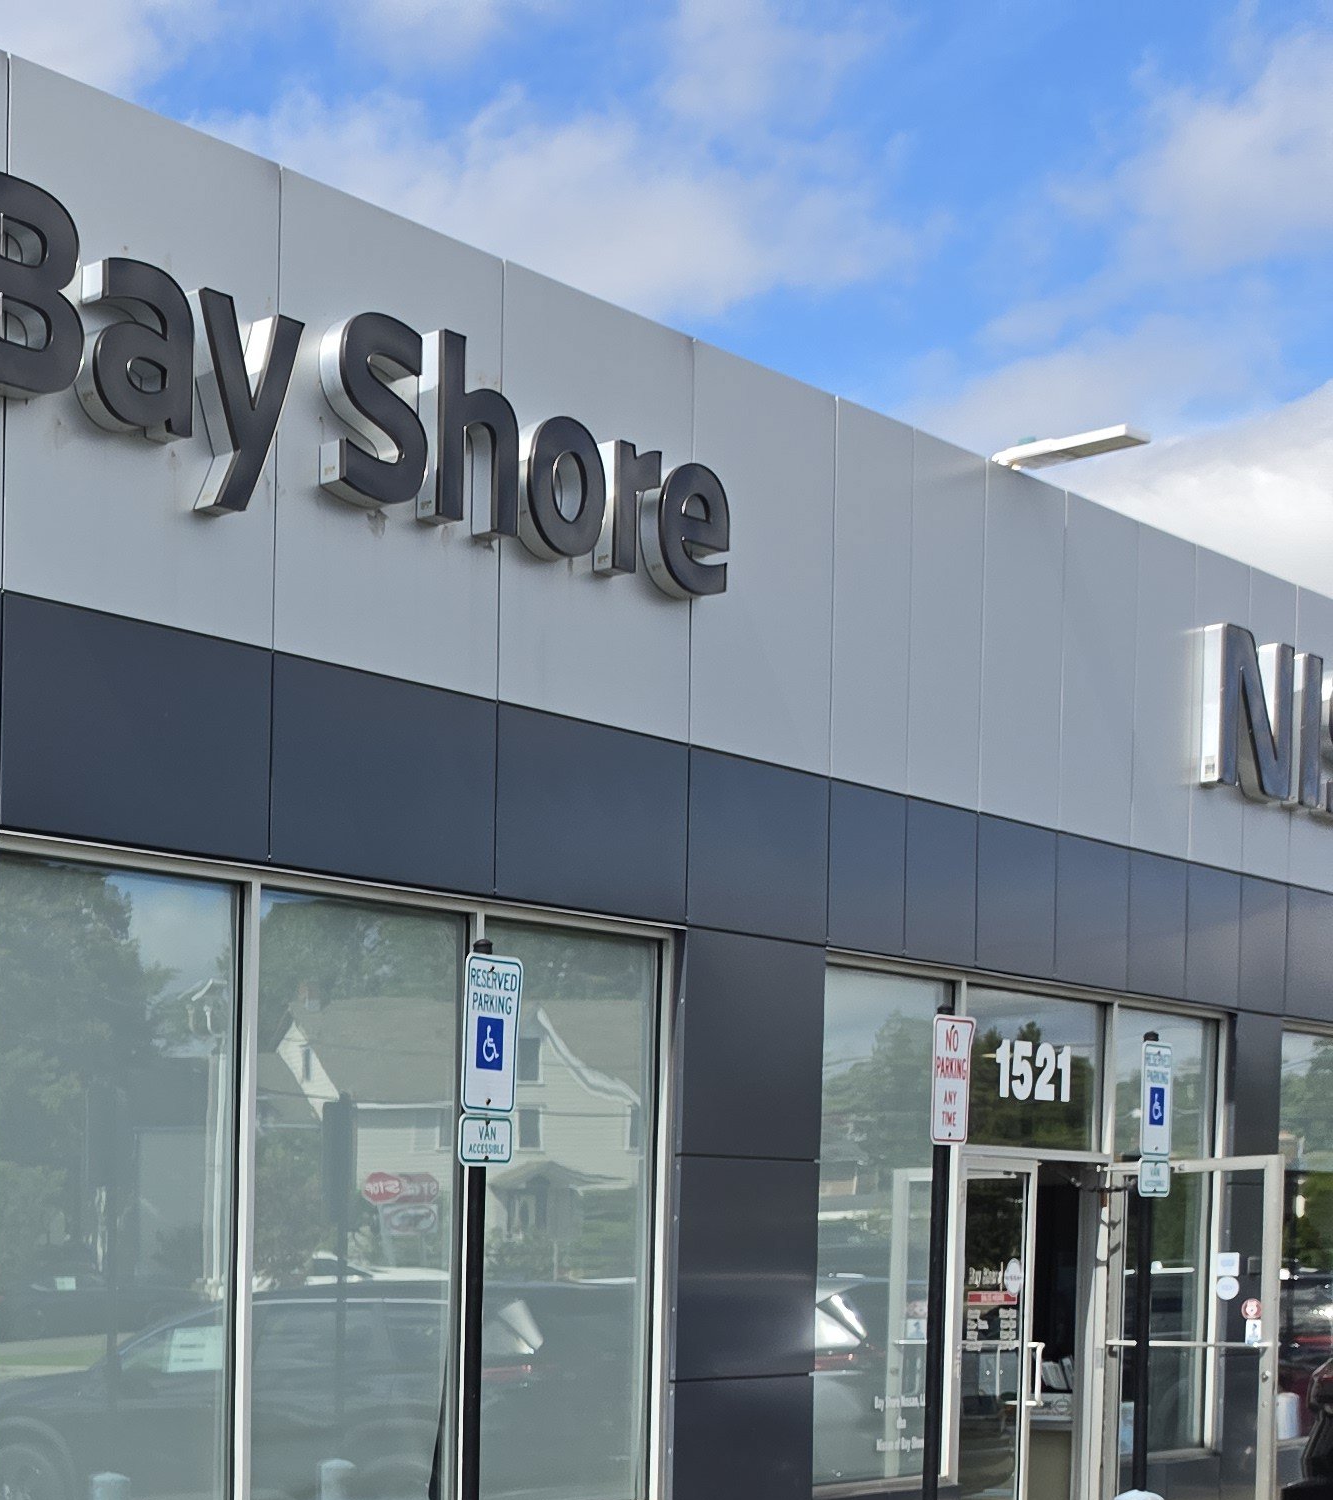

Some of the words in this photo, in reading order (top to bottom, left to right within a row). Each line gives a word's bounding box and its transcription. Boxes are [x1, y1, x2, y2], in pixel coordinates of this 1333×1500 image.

[319, 311, 730, 599] Shore
[1200, 622, 1333, 812] NI
[470, 967, 518, 992] RESERVED
[472, 992, 513, 1015] PARKING
[945, 1029, 959, 1052] NO
[935, 1055, 967, 1081] PARKING
[995, 1038, 1072, 1103] 1521
[943, 1090, 958, 1107] ANY
[942, 1111, 957, 1127] TIME
[478, 1125, 497, 1141] VAN
[468, 1143, 504, 1155] ACCESSIBLE
